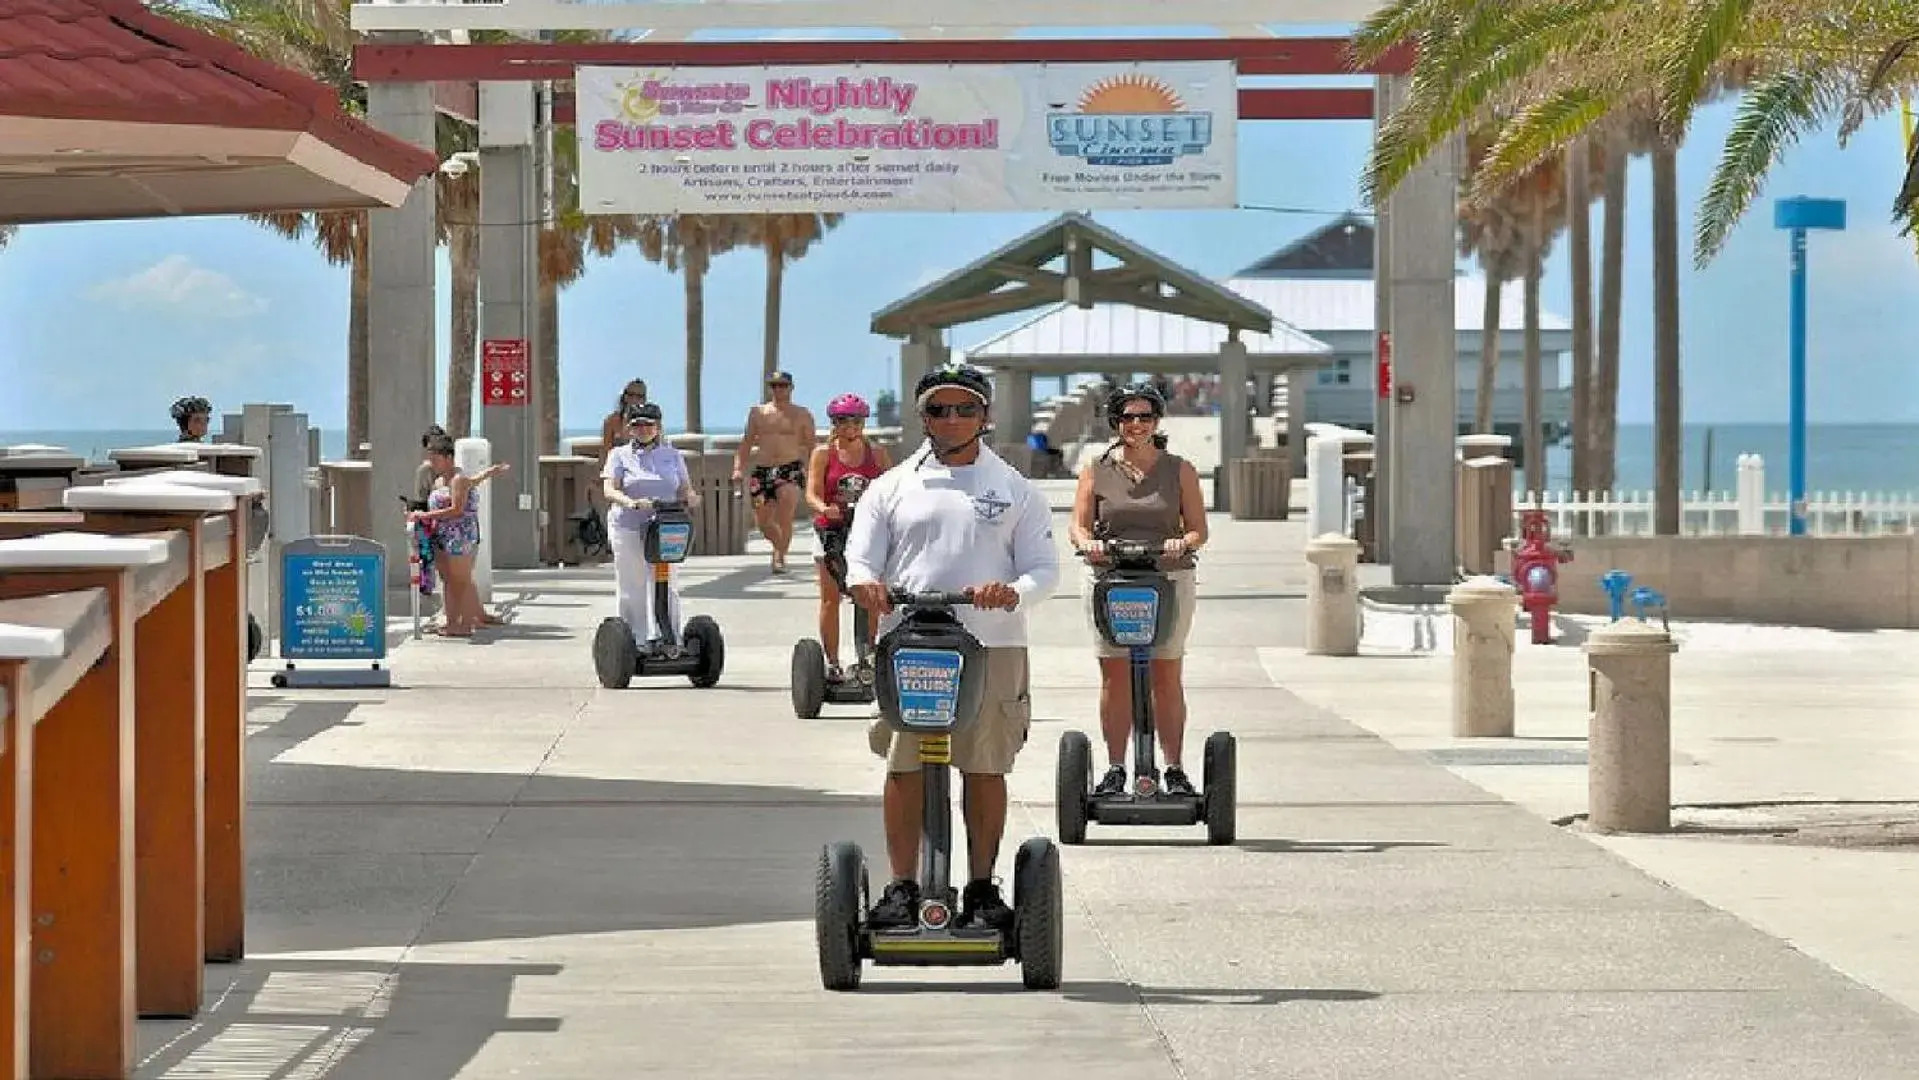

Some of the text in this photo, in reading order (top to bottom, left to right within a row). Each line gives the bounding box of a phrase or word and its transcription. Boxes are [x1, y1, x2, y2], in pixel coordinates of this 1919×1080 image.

[765, 77, 917, 115] Nightly
[595, 118, 999, 151] Sunset Celebration!
[1052, 118, 1206, 142] SUNSET
[1083, 143, 1175, 155] Cinema
[651, 162, 690, 174] hours
[693, 162, 740, 174] before
[780, 162, 790, 174] 2
[792, 162, 833, 173] hours
[836, 161, 871, 173] after
[875, 162, 919, 173] sunset
[925, 161, 959, 176] daily
[1074, 172, 1120, 183] Movies
[1123, 171, 1162, 182] Under
[899, 666, 956, 678] SEGWAY
[900, 679, 952, 692] TOURS
